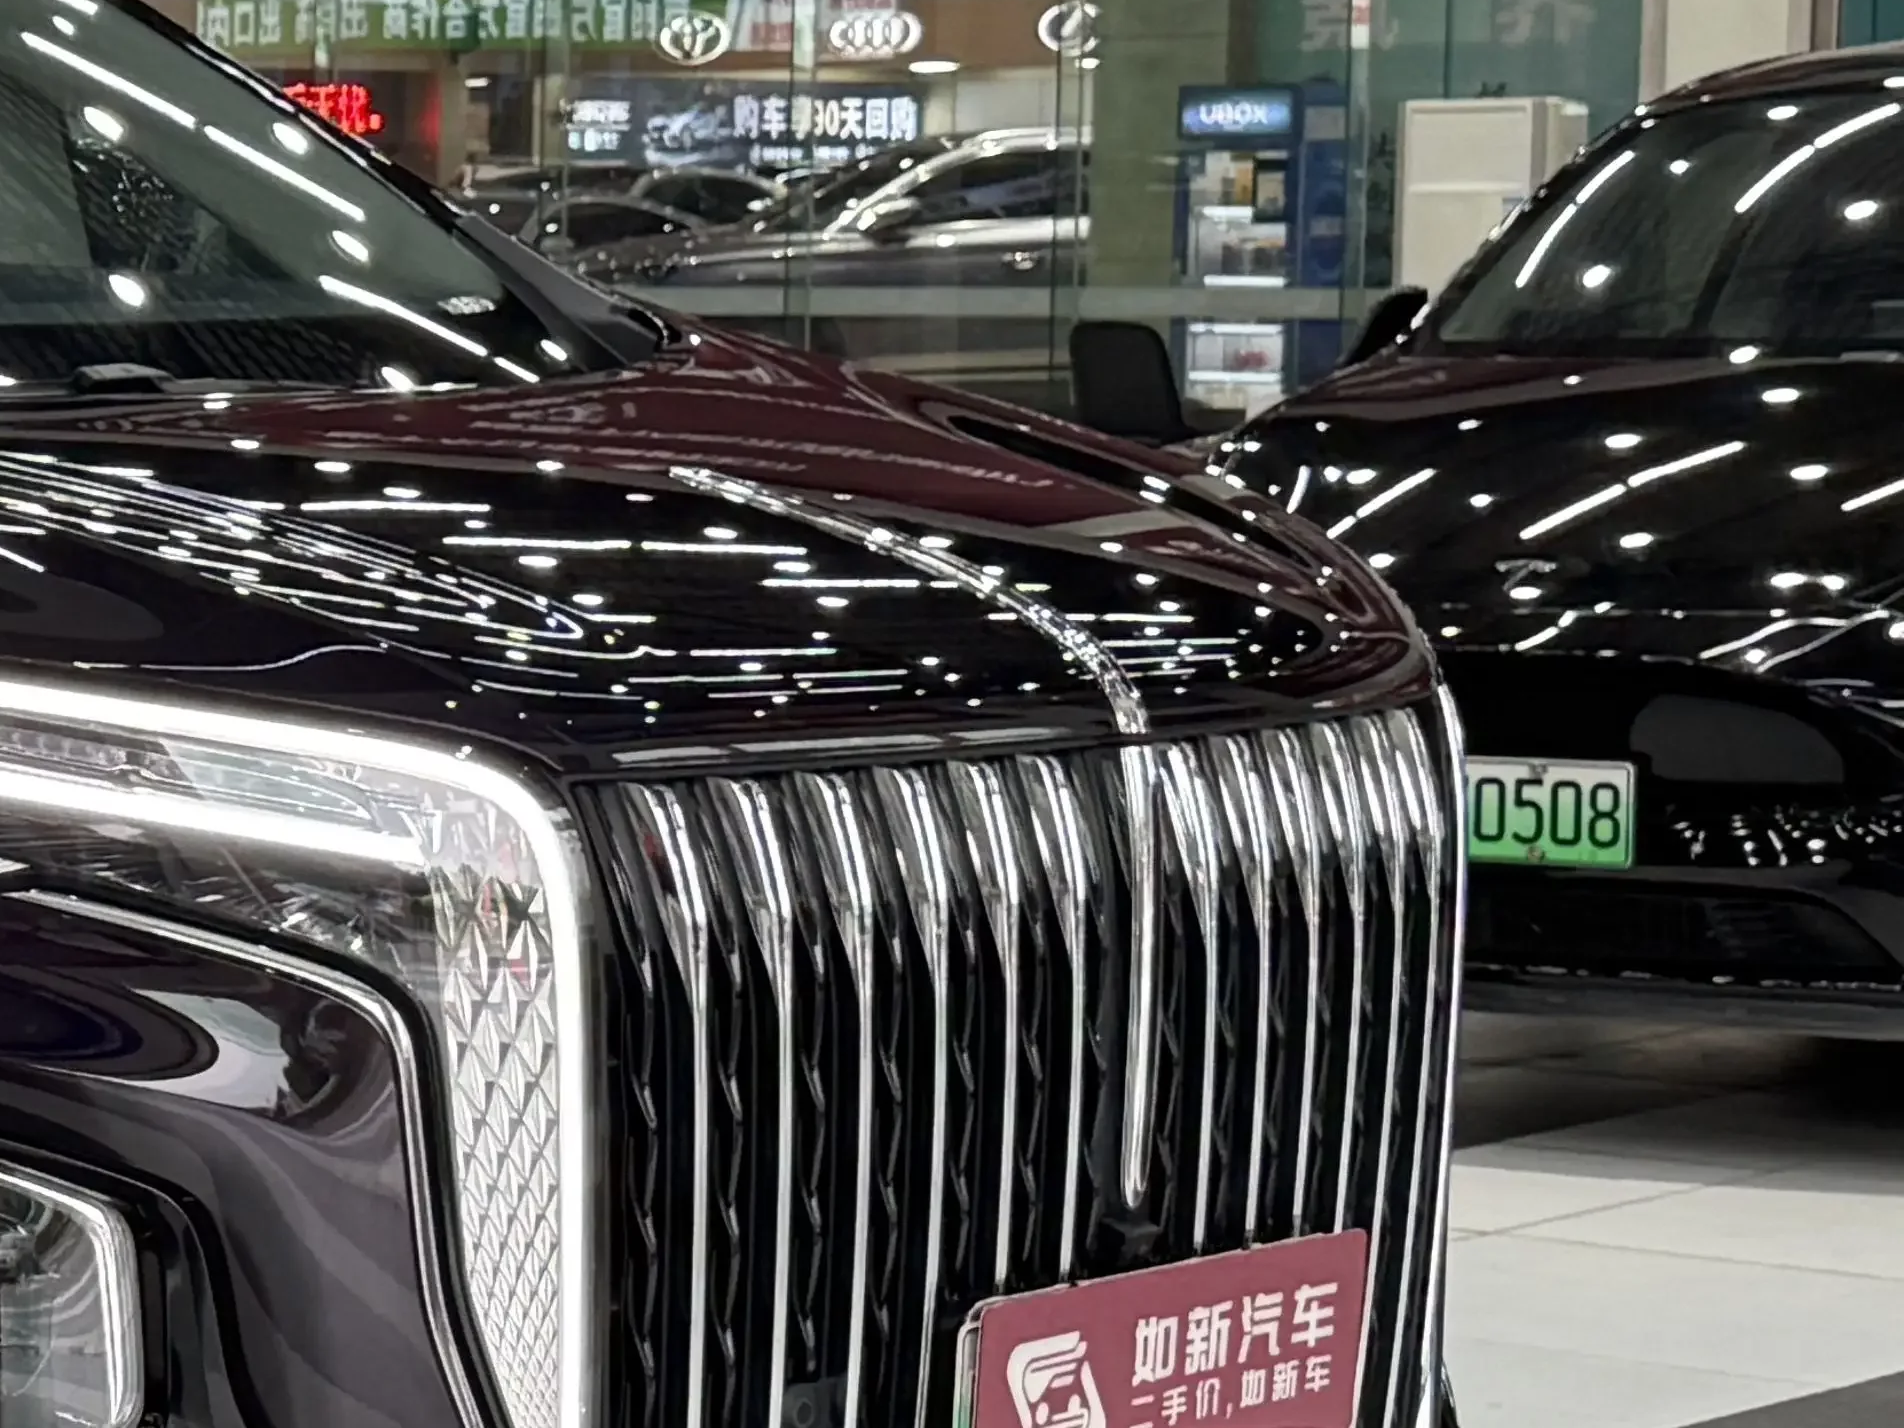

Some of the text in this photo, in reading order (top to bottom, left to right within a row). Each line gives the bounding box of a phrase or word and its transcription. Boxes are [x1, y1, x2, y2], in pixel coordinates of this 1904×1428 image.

[1472, 777, 1622, 850] 0508
[1131, 1281, 1338, 1387] 如新汽车
